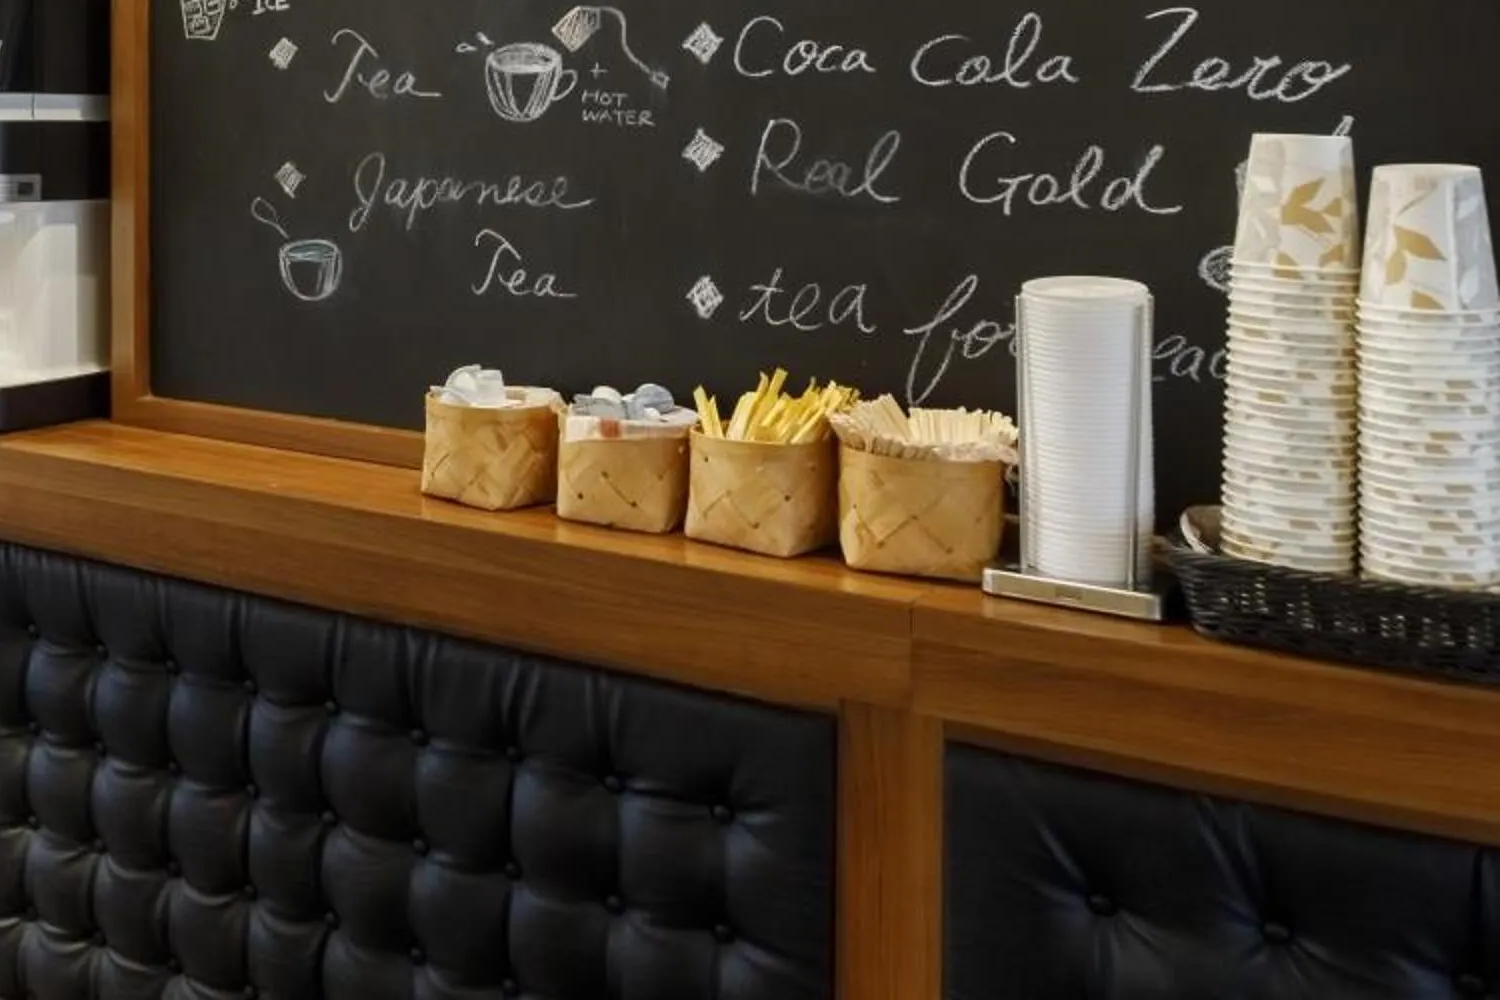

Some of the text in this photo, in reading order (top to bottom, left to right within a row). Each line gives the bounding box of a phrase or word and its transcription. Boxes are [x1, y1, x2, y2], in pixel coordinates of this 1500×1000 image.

[323, 28, 442, 104] Tea
[733, 15, 877, 78] Coca
[1129, 6, 1352, 103] Zero
[581, 89, 628, 108] HOT
[582, 109, 655, 126] WATER
[348, 152, 594, 236] Japanese
[750, 117, 1184, 217] Real Gold
[471, 227, 577, 298] Tea
[738, 267, 877, 334] tea
